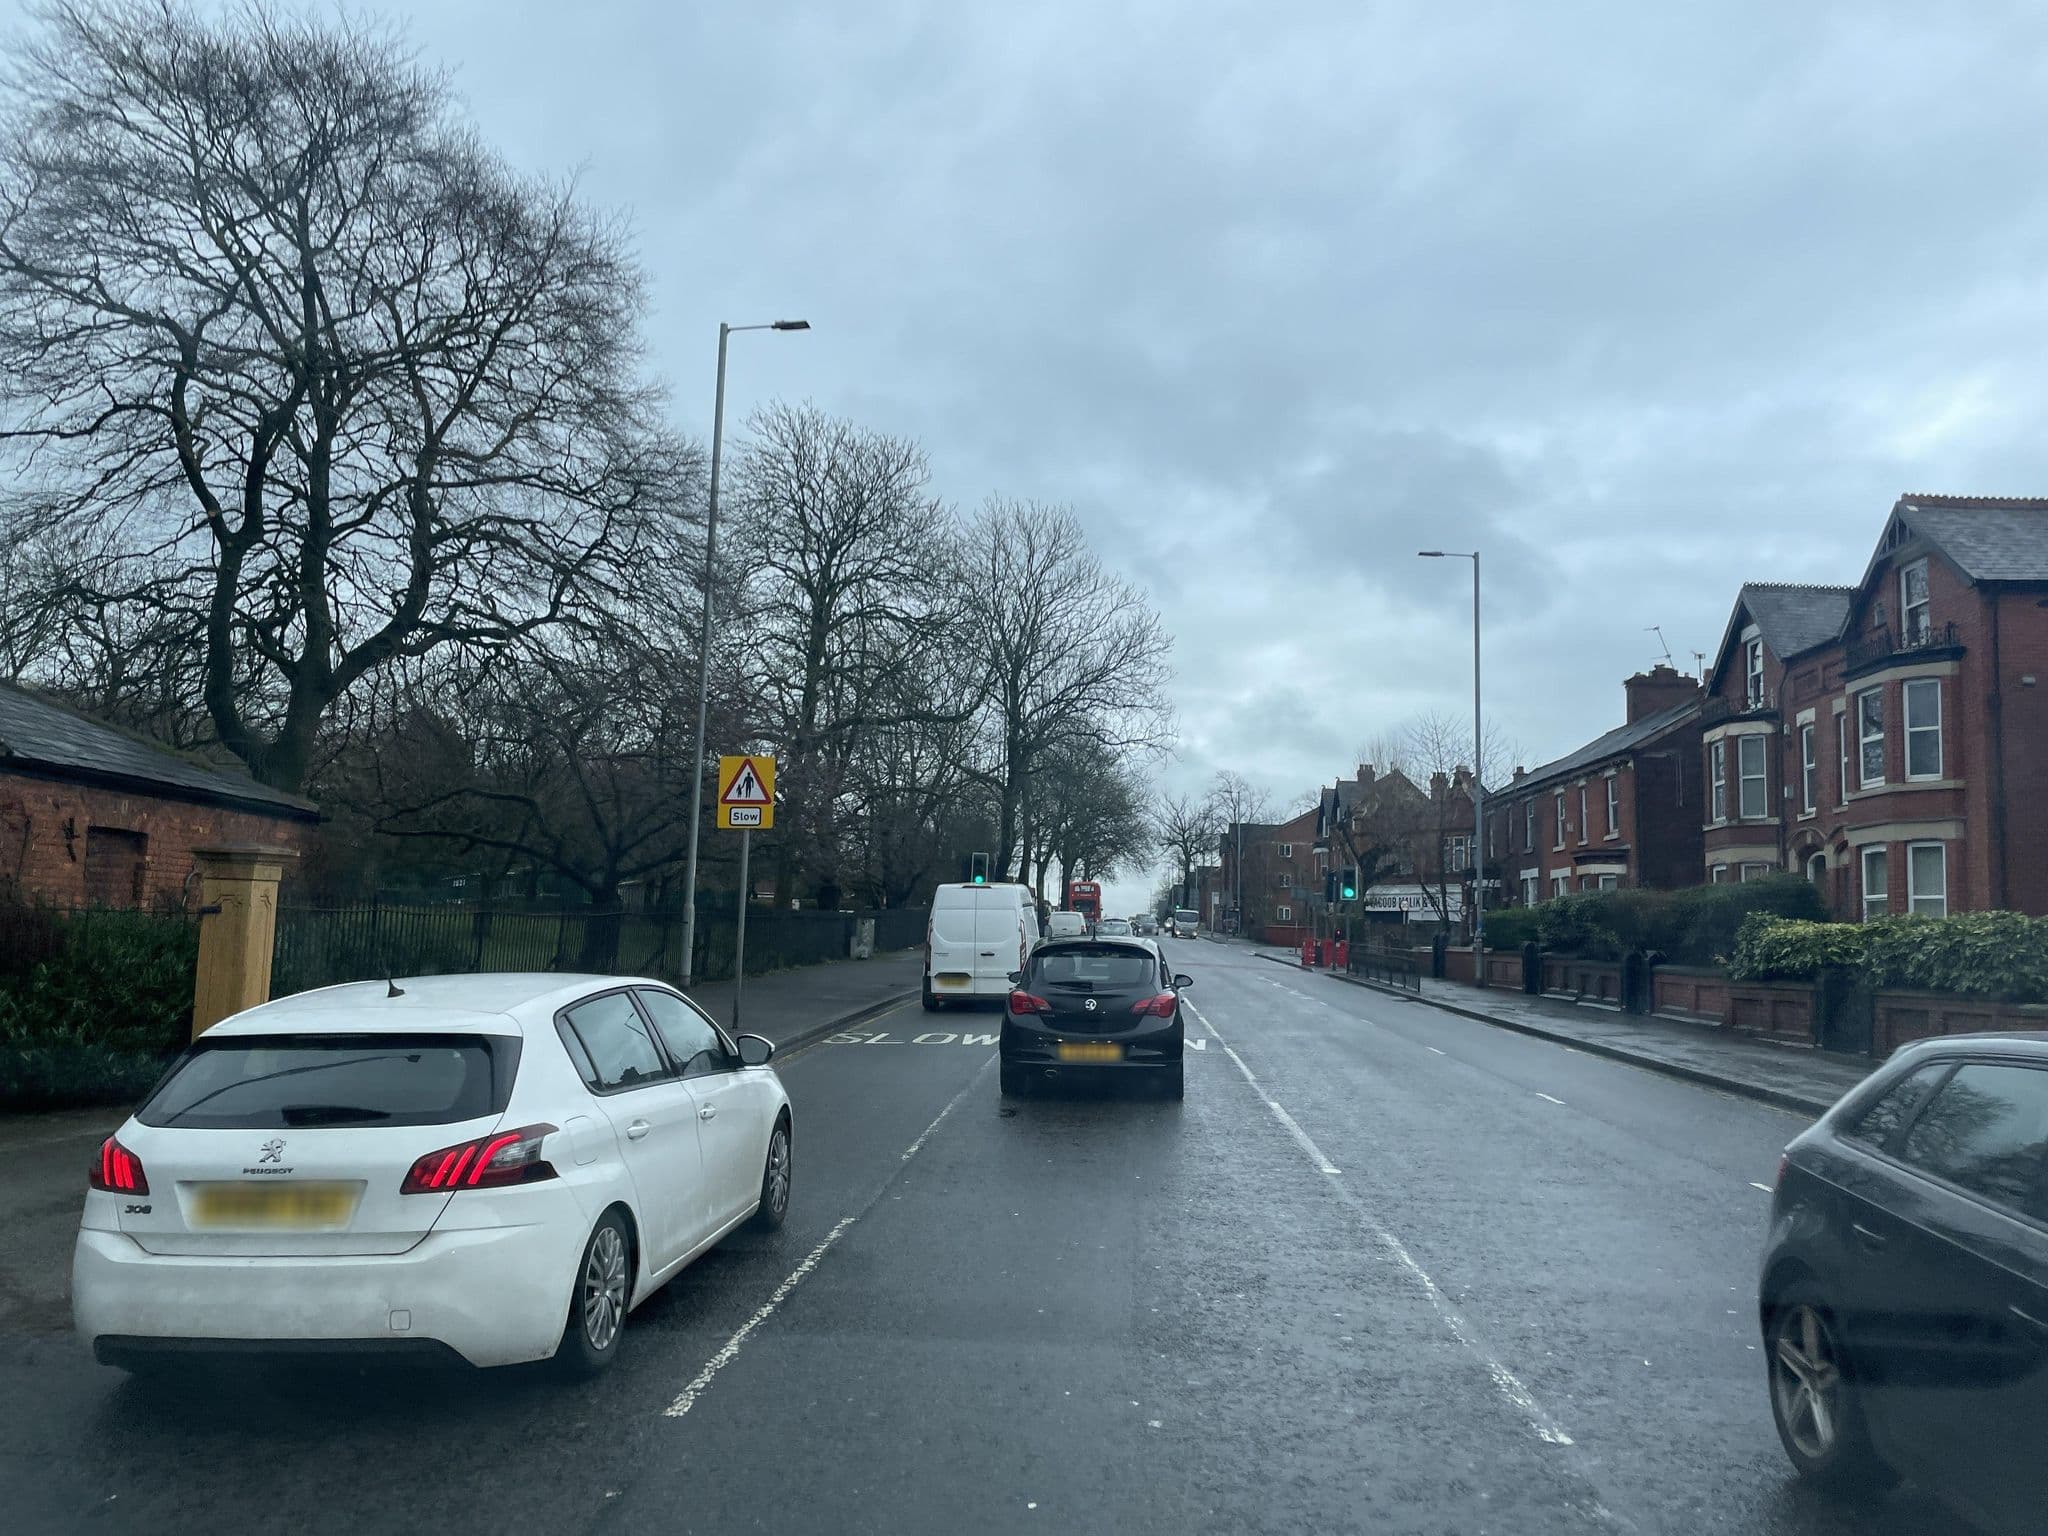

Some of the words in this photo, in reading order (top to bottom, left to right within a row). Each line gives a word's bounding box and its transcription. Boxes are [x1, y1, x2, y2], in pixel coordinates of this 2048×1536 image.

[733, 812, 758, 821] Slow
[820, 1032, 1001, 1046] SLOW
[243, 1167, 294, 1175] PEUGEOT
[125, 1204, 152, 1215] 308
